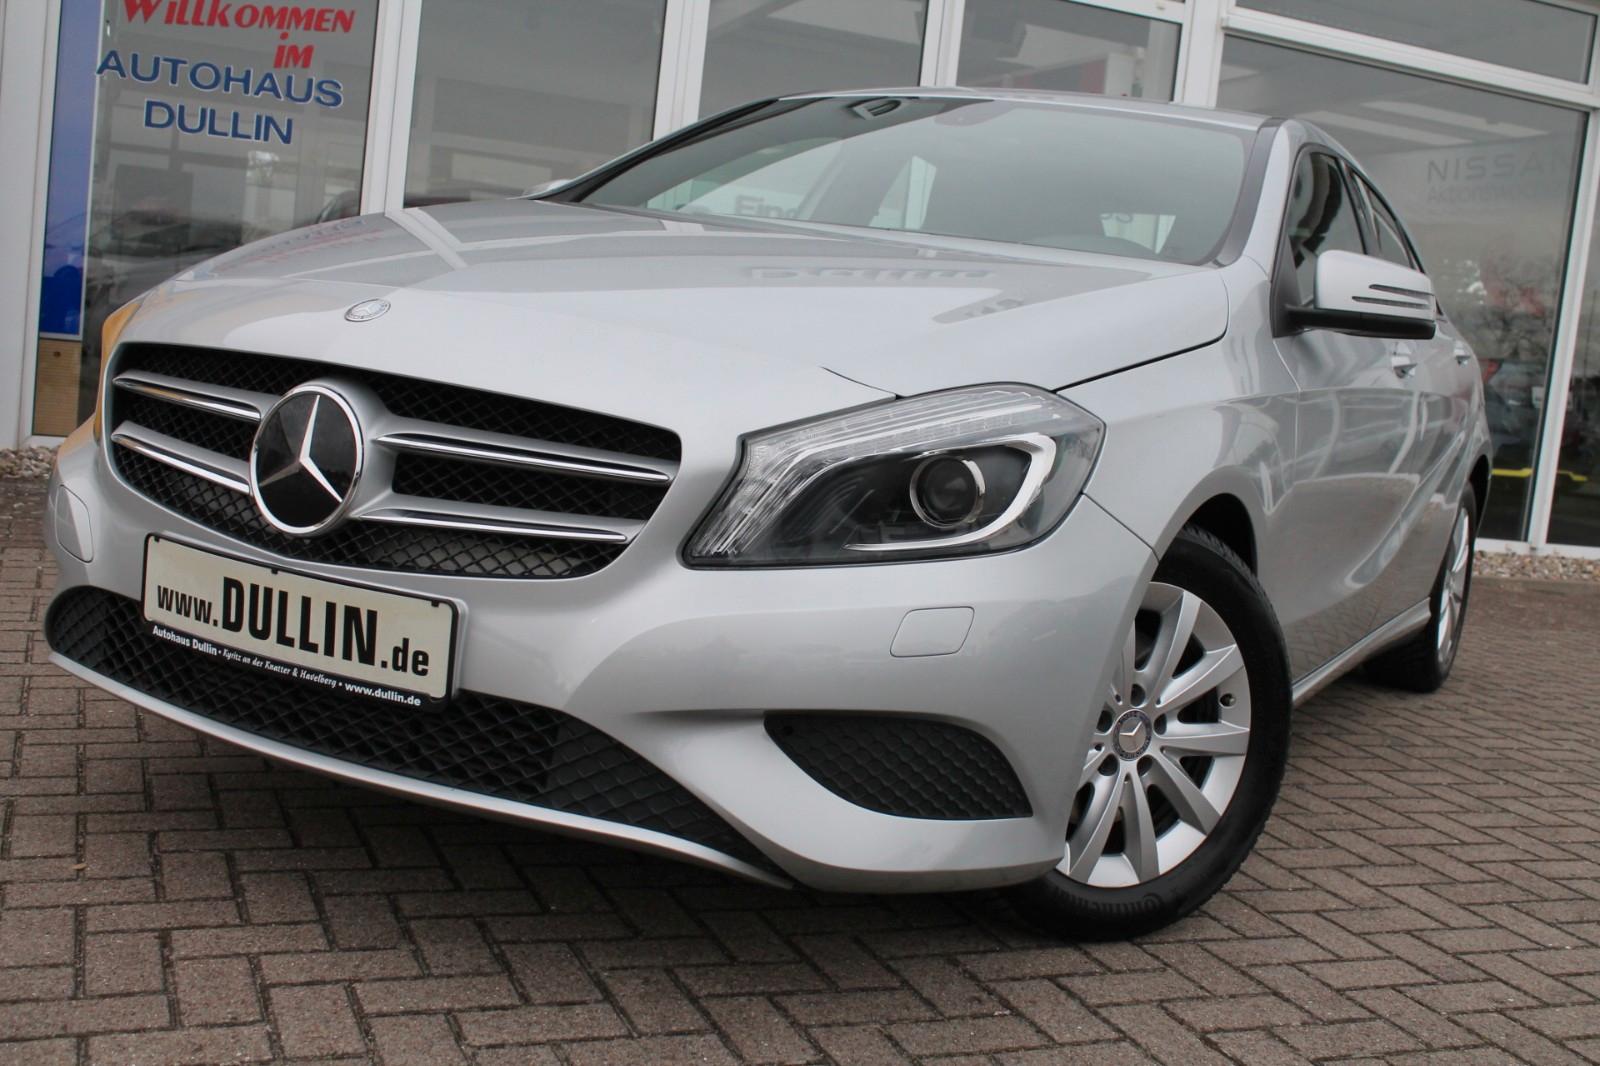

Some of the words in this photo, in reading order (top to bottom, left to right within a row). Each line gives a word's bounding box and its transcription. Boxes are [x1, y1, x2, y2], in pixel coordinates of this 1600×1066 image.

[96, 49, 344, 108] AUTOHAUS
[144, 99, 294, 145] DULLIN
[157, 576, 429, 676] www.DULLIN.de
[152, 625, 191, 647] Autohaus
[192, 638, 218, 656] Dullin
[252, 657, 264, 668] der
[264, 661, 292, 675] Knatter
[292, 667, 299, 678] &
[300, 669, 338, 689] Havelberg
[344, 682, 422, 706] www.dullin.de
